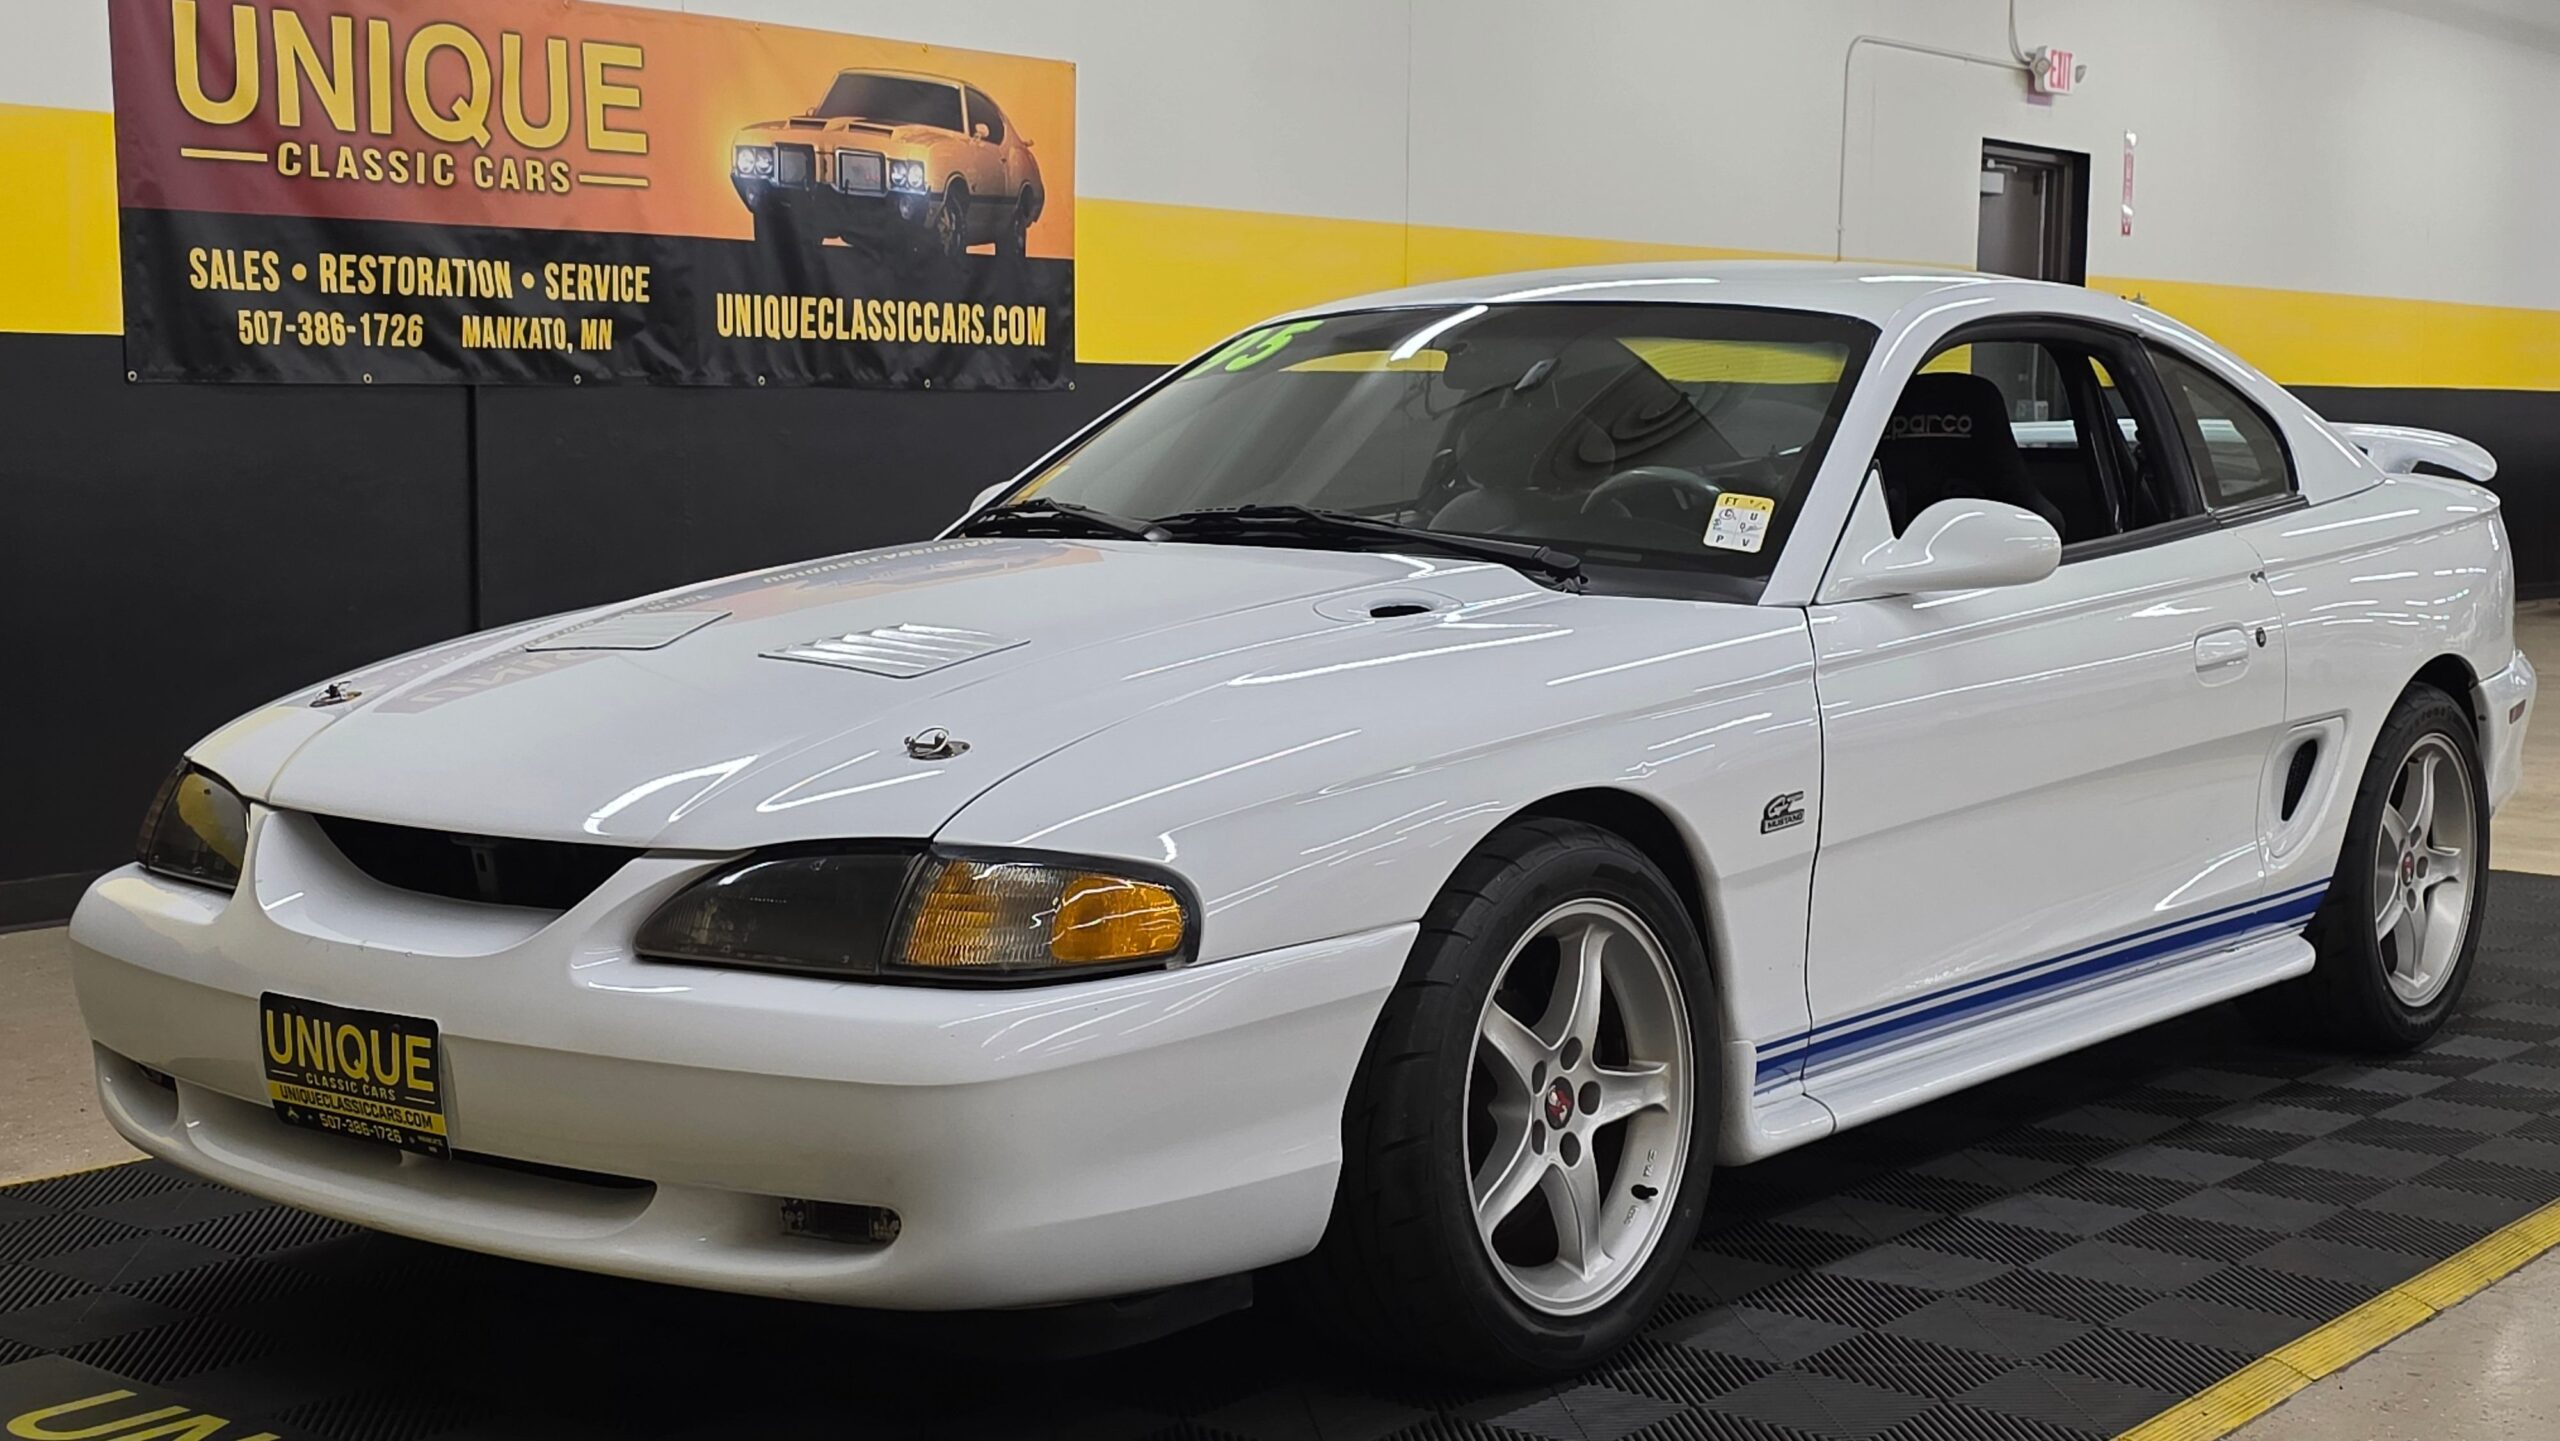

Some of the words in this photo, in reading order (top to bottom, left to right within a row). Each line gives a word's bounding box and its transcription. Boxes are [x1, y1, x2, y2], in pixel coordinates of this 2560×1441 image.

[171, 0, 648, 154] UNIQUE
[277, 142, 455, 187] CLASSIC
[474, 156, 570, 193] CARS
[189, 247, 280, 292] SALES
[319, 252, 514, 300] RESTORATION
[544, 261, 650, 303] SERVICE
[238, 310, 424, 348] 507-386-1726
[462, 314, 574, 354] MANKATO,
[581, 318, 613, 351] MN
[716, 293, 1047, 346] UNIQUECLASSICCARS.COM
[1884, 414, 1973, 440] parco
[266, 1009, 434, 1092] UNIQUE
[280, 1084, 433, 1129] UNIQUECLASSICCARS.COM
[306, 1072, 358, 1094] CLASSIC
[362, 1083, 396, 1101] CARS
[319, 1112, 402, 1143] 507-386-1726
